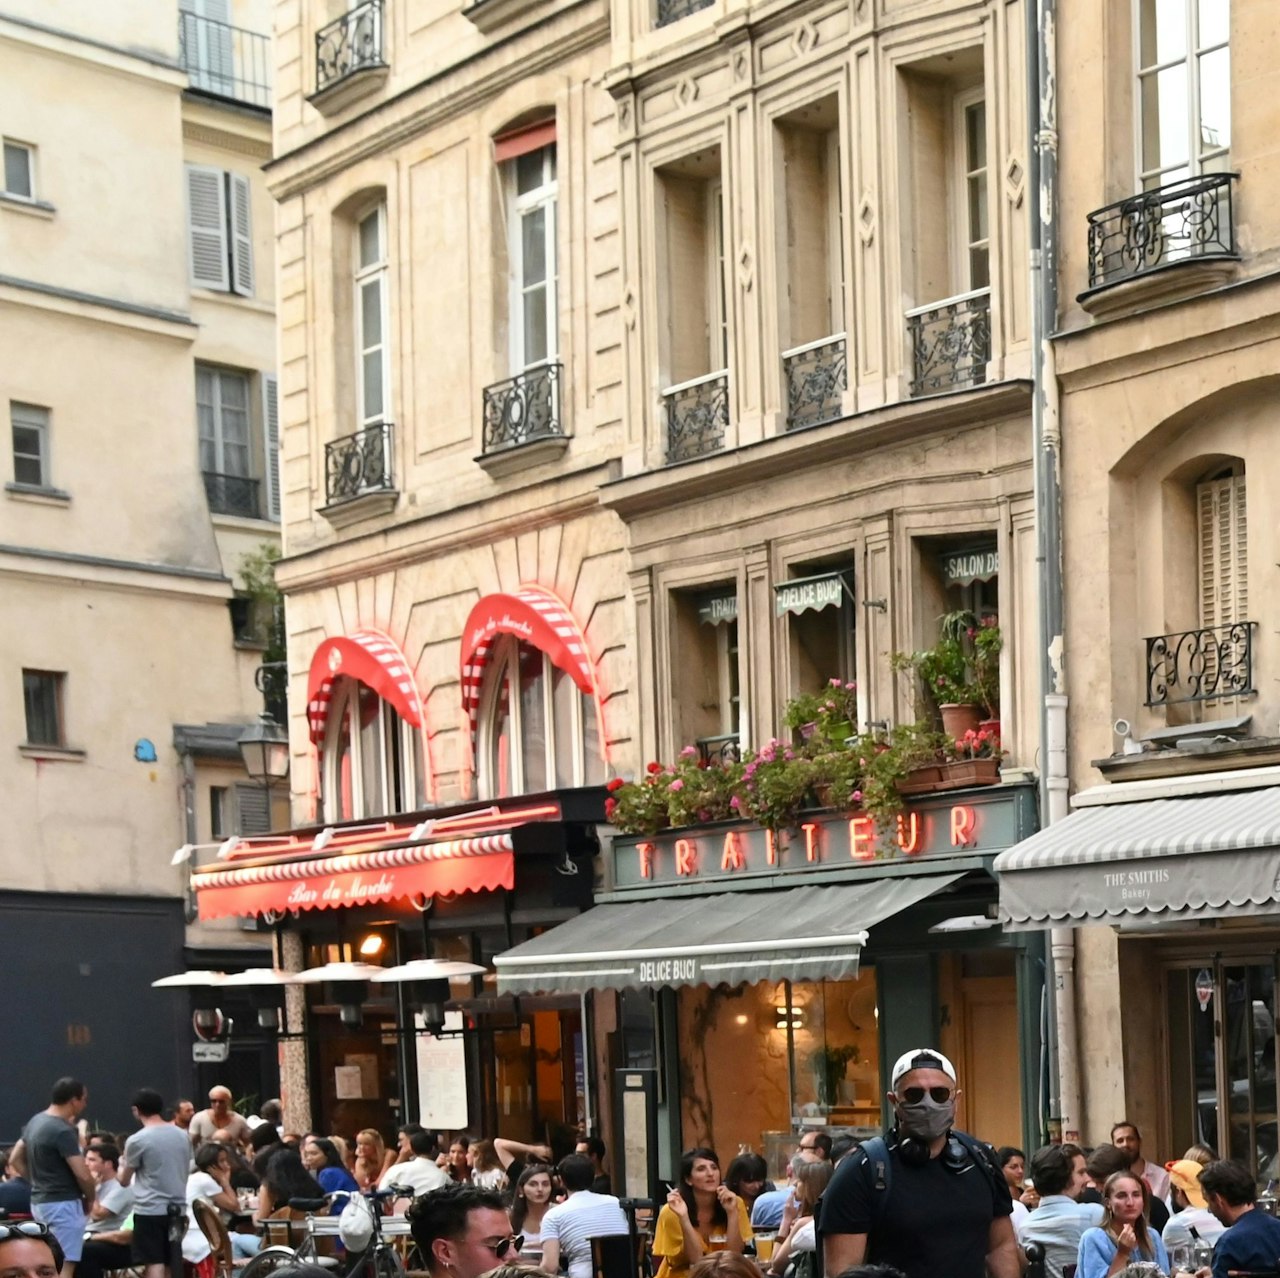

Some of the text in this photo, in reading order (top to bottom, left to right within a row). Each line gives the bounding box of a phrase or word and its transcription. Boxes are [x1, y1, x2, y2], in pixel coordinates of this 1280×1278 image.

[948, 554, 984, 578] SALON
[782, 579, 840, 609] DELICE BUCI
[635, 806, 972, 879] TRAITEUR
[287, 873, 395, 903] Bar du Marché
[1103, 869, 1170, 887] THE SMITHS
[1122, 887, 1151, 900] Bakery
[640, 959, 696, 982] DELICE BUCI
